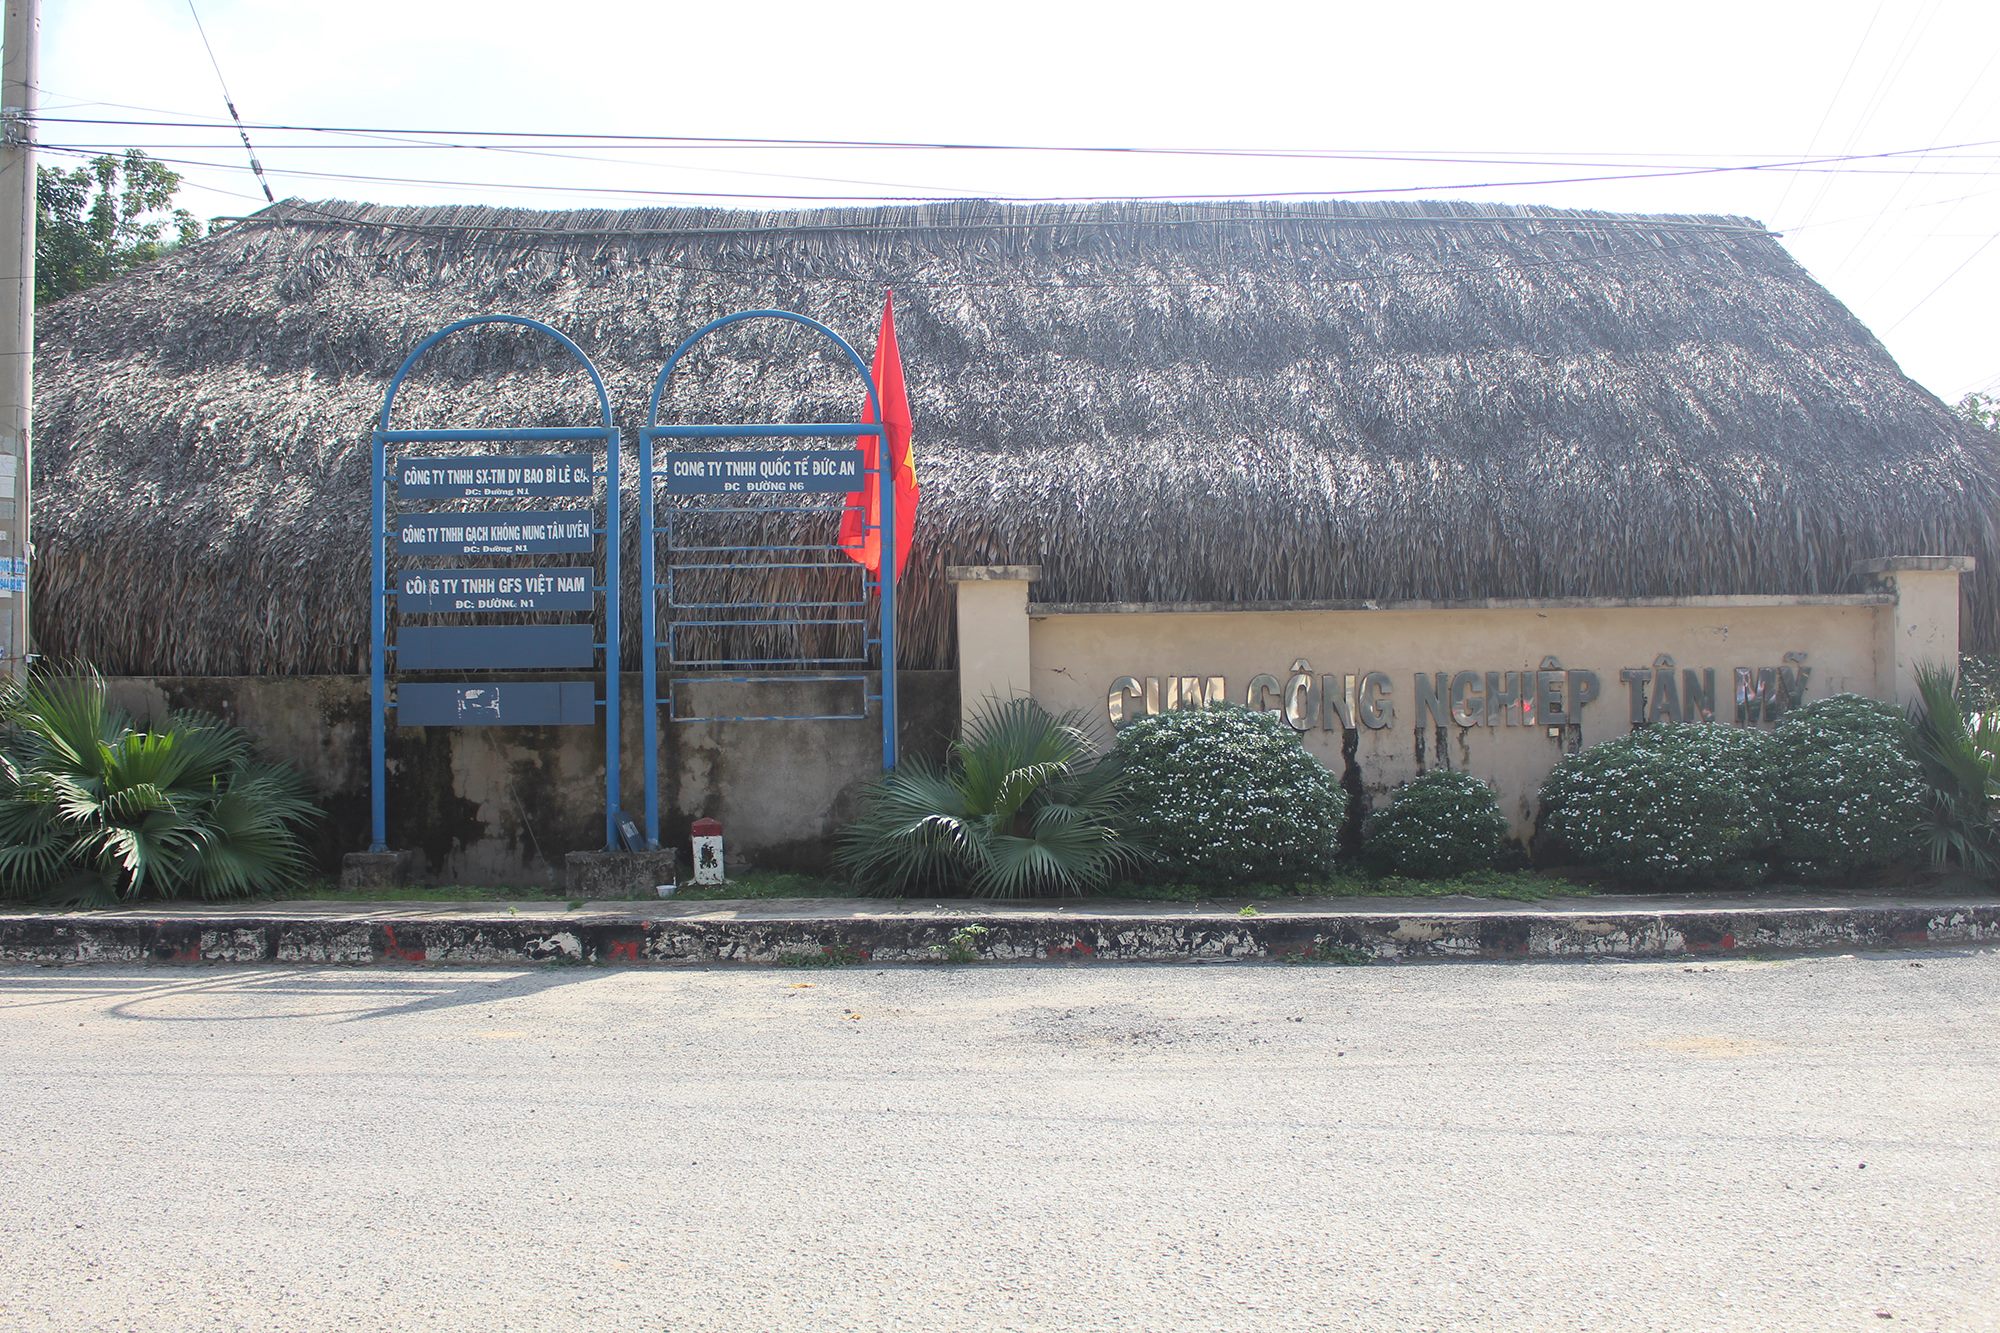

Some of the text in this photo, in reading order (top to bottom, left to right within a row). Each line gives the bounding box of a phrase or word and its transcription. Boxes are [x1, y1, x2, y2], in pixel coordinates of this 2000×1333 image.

[404, 466, 430, 485] CÔNG
[432, 470, 445, 484] TY
[447, 470, 473, 484] TNHH
[476, 469, 506, 484] SX-TM
[508, 468, 521, 484] DV
[524, 468, 544, 484] BAO
[546, 465, 556, 483] BÌ
[707, 462, 722, 477] TY
[725, 462, 756, 477] TNHH
[760, 455, 791, 478] QUỐC
[794, 455, 809, 476] TẾ
[812, 457, 837, 476] ĐỨC
[838, 460, 855, 476] AN
[516, 487, 530, 495] N1
[747, 480, 786, 491] ĐƯỜNG
[789, 482, 804, 490] N6
[402, 524, 426, 543] CÔNG
[427, 527, 439, 543] TY
[440, 527, 464, 542] TNHH
[465, 526, 489, 544] GẠCH
[522, 525, 545, 540] NUNG
[547, 521, 565, 539] TÂN
[566, 520, 590, 538] UYÊN
[515, 544, 529, 552] N1
[442, 579, 459, 594] TY
[461, 578, 495, 594] TNHH
[498, 577, 523, 593] GFS
[524, 573, 554, 596] VIỆT
[557, 577, 585, 592] NAM
[455, 600, 475, 609] ĐC:
[520, 599, 535, 608] N1
[1247, 658, 1394, 732] CÔNG
[1619, 652, 1716, 724] TÂN
